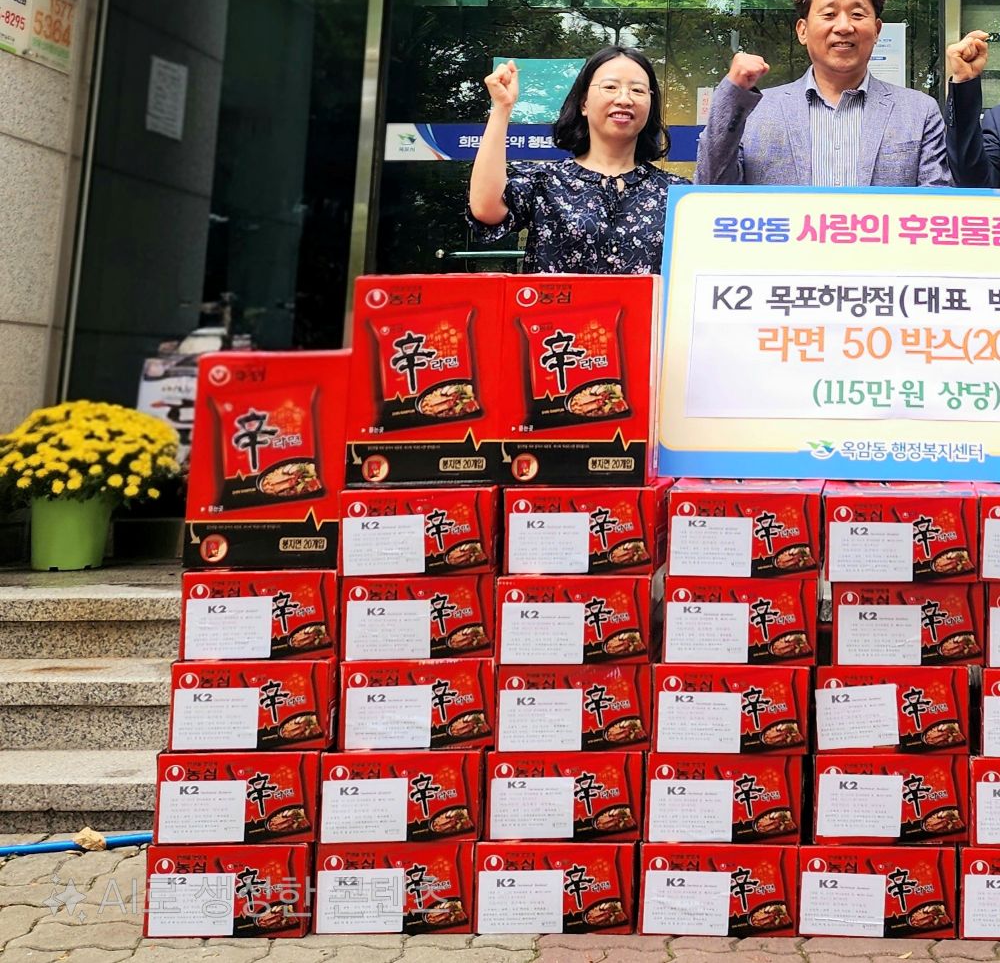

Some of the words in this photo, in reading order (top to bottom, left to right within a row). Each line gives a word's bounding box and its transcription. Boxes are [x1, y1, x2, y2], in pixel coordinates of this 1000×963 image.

[713, 216, 790, 243] 옥암동
[796, 214, 889, 245] 사랑의
[538, 290, 571, 304] 농심
[712, 284, 752, 311] K2
[757, 326, 825, 363] 라면
[840, 442, 888, 461] 옥암동
[893, 441, 984, 461] 행정복지센터
[851, 527, 868, 535] K2
[859, 612, 877, 620] K2
[194, 694, 212, 702] K2
[368, 694, 385, 702] K2
[517, 697, 535, 705] K2
[832, 694, 850, 703] K2
[840, 781, 857, 789] K2
[180, 786, 198, 795] K2
[340, 787, 358, 795] K2
[668, 787, 685, 795] K2
[497, 879, 515, 887] K2
[667, 878, 685, 886] K2
[820, 880, 837, 888] K2
